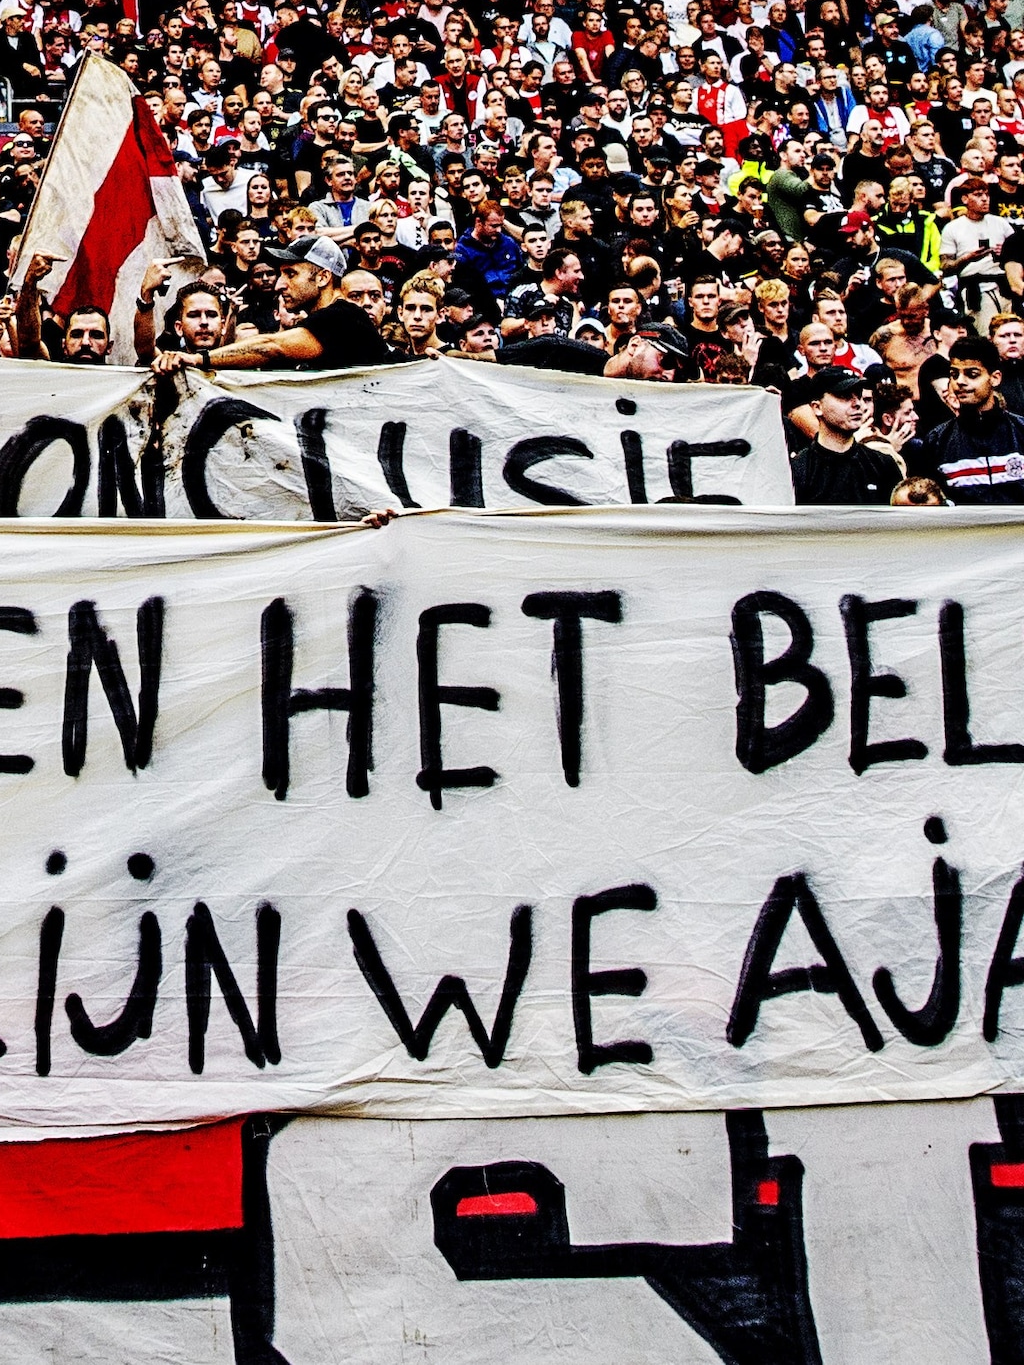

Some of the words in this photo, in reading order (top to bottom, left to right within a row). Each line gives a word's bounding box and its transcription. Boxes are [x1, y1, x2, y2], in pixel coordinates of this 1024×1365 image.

[260, 585, 624, 810] HET
[730, 590, 1024, 775] BEL
[346, 883, 659, 1076] WE
